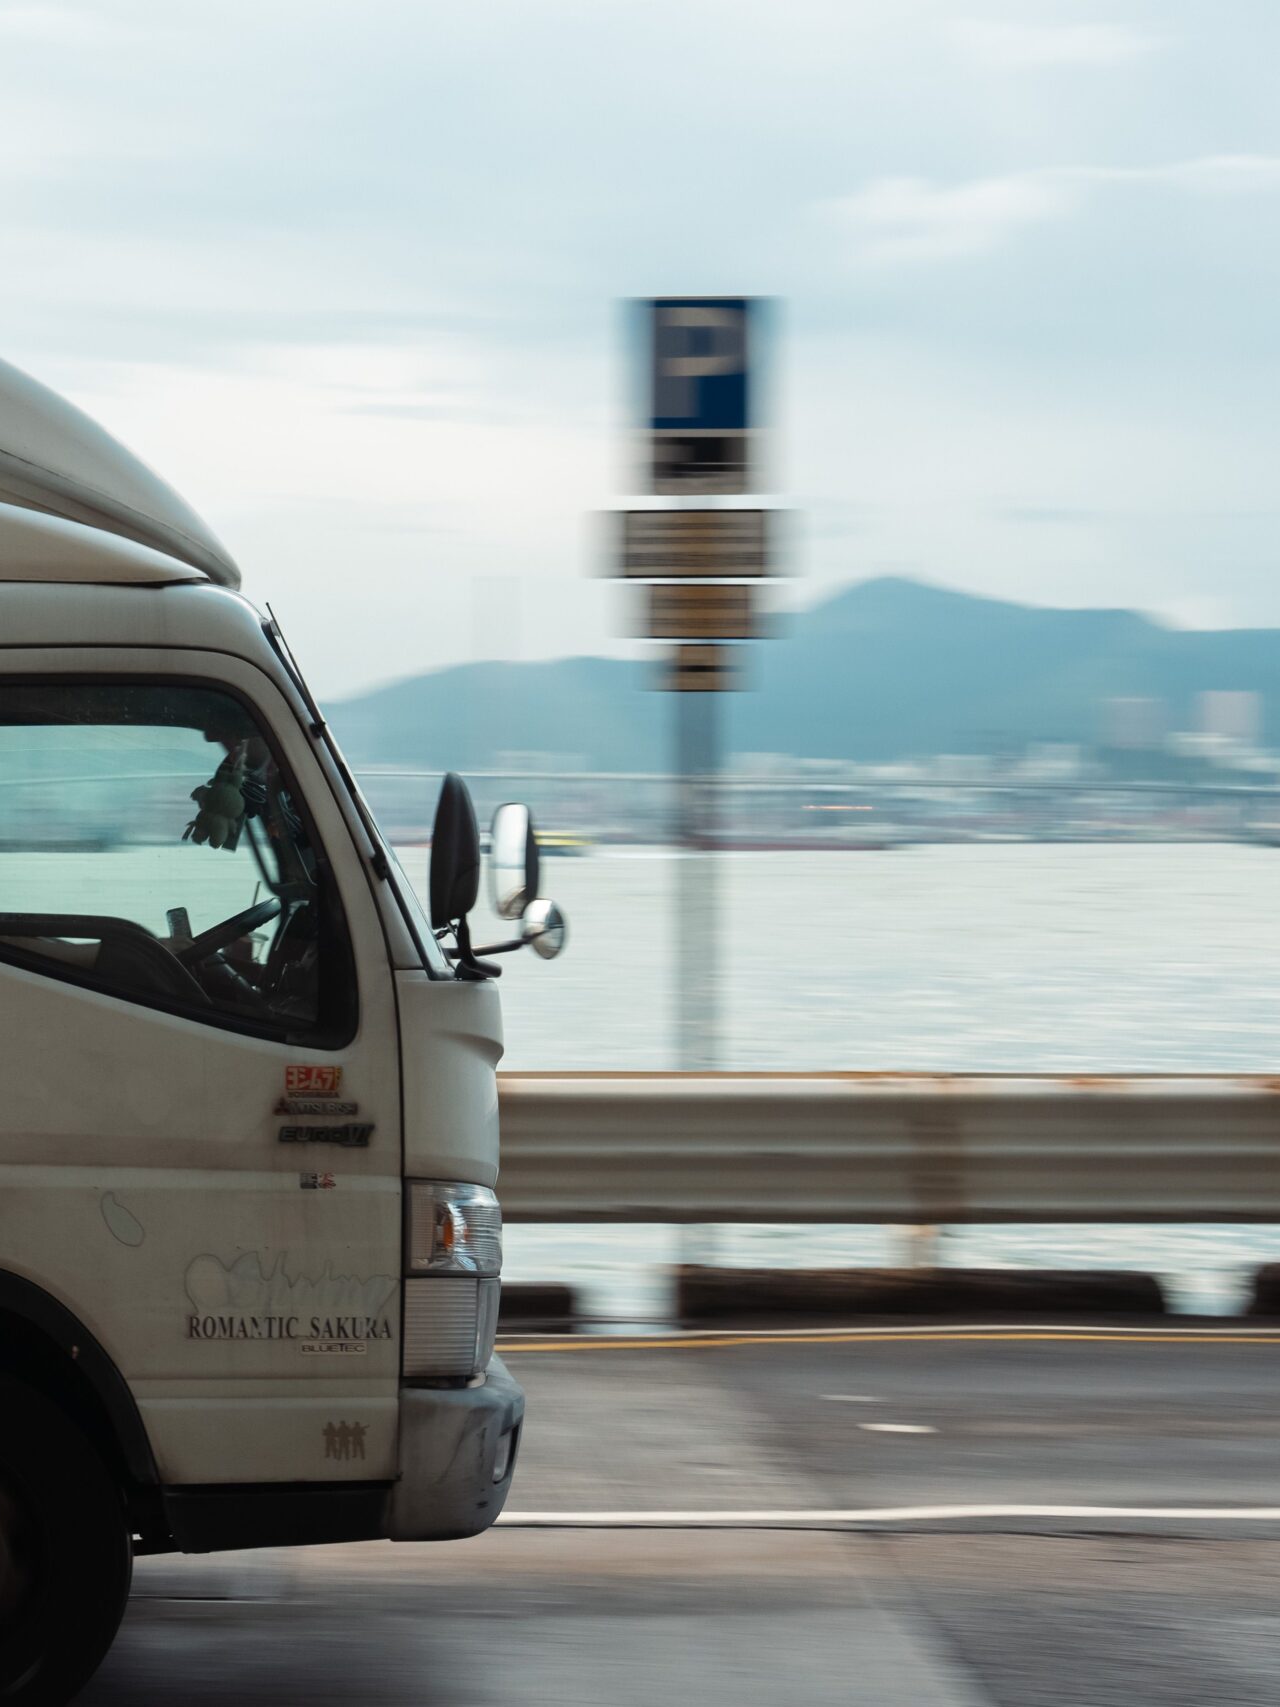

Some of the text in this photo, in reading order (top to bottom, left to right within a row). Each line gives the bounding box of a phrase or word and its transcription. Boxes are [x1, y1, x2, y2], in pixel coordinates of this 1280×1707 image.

[287, 1067, 333, 1090] ヨシムラ
[279, 1126, 346, 1143] EURO
[188, 1315, 393, 1339] ROMANTIC SAKURA
[301, 1342, 366, 1353] BLUETEC
